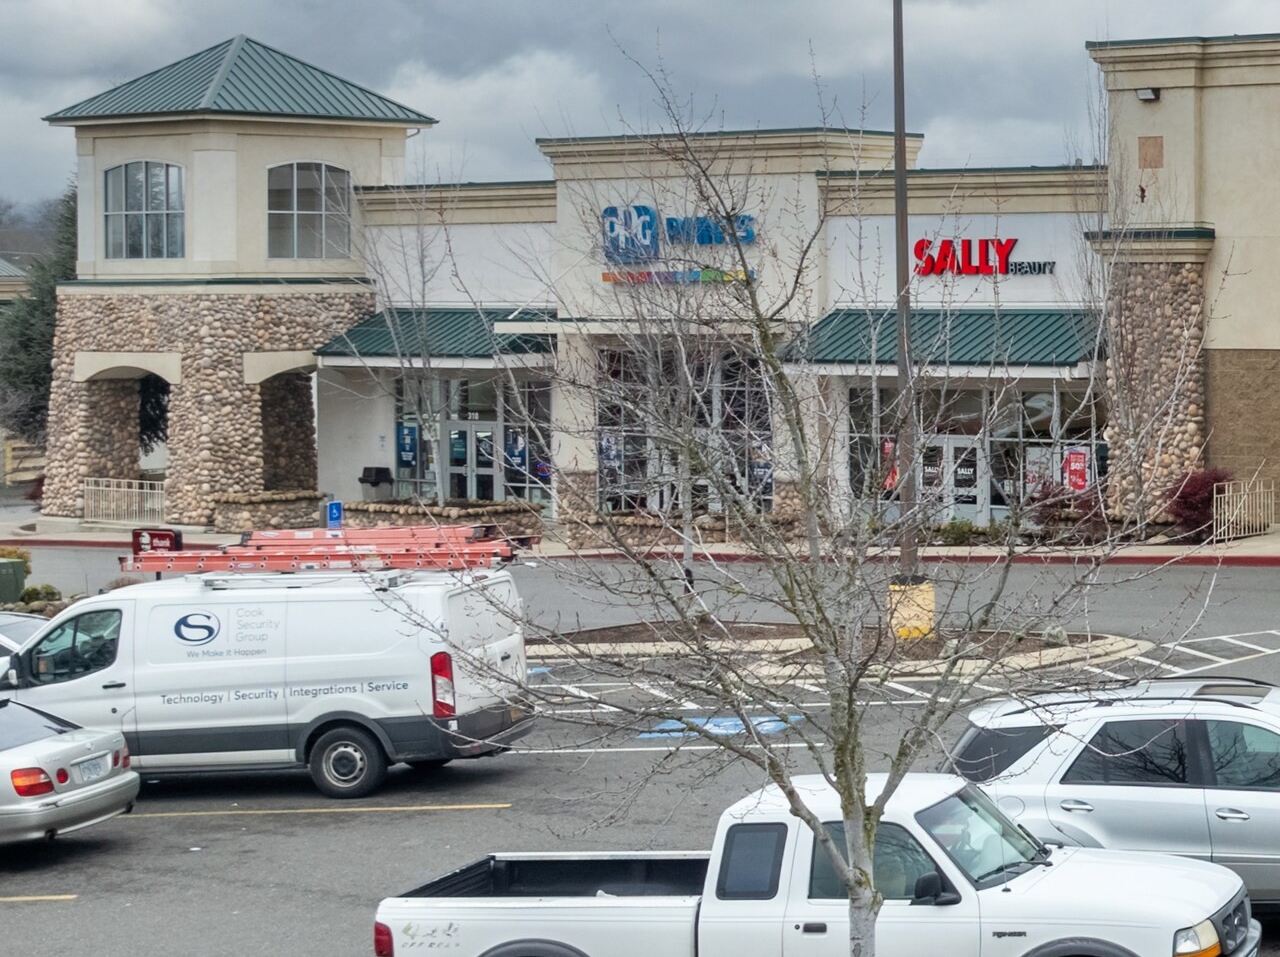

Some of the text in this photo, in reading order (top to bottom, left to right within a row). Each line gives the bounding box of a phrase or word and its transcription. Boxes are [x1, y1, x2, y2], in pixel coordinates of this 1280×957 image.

[914, 238, 1056, 275] SALLY BEAUTY
[236, 607, 264, 618] Cook
[236, 619, 280, 631] Security
[235, 631, 268, 644] Group
[202, 650, 224, 658] Make
[234, 648, 267, 658] Happen
[161, 681, 409, 705] Technology Security Integrations Service
